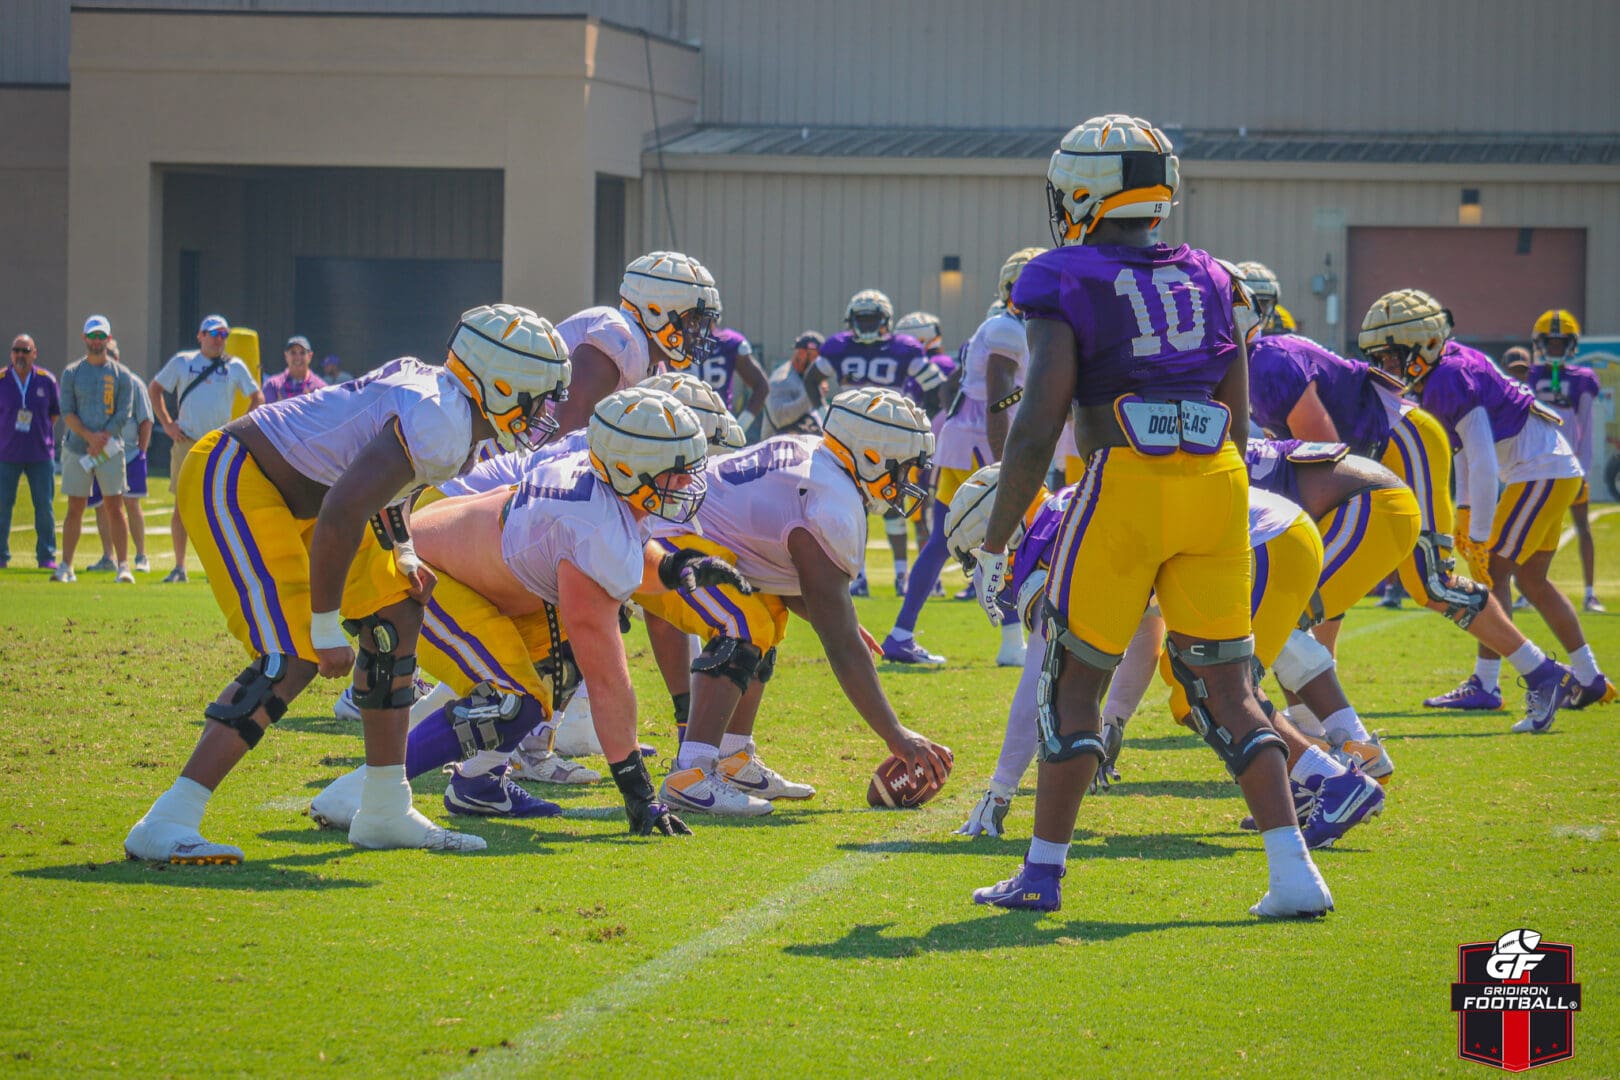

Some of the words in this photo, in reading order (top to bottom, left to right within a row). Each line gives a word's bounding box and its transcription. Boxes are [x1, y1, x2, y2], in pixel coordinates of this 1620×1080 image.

[1114, 264, 1206, 356] 10
[103, 375, 115, 415] LSU
[985, 561, 1003, 618] TIGERS
[1022, 892, 1041, 901] LSU
